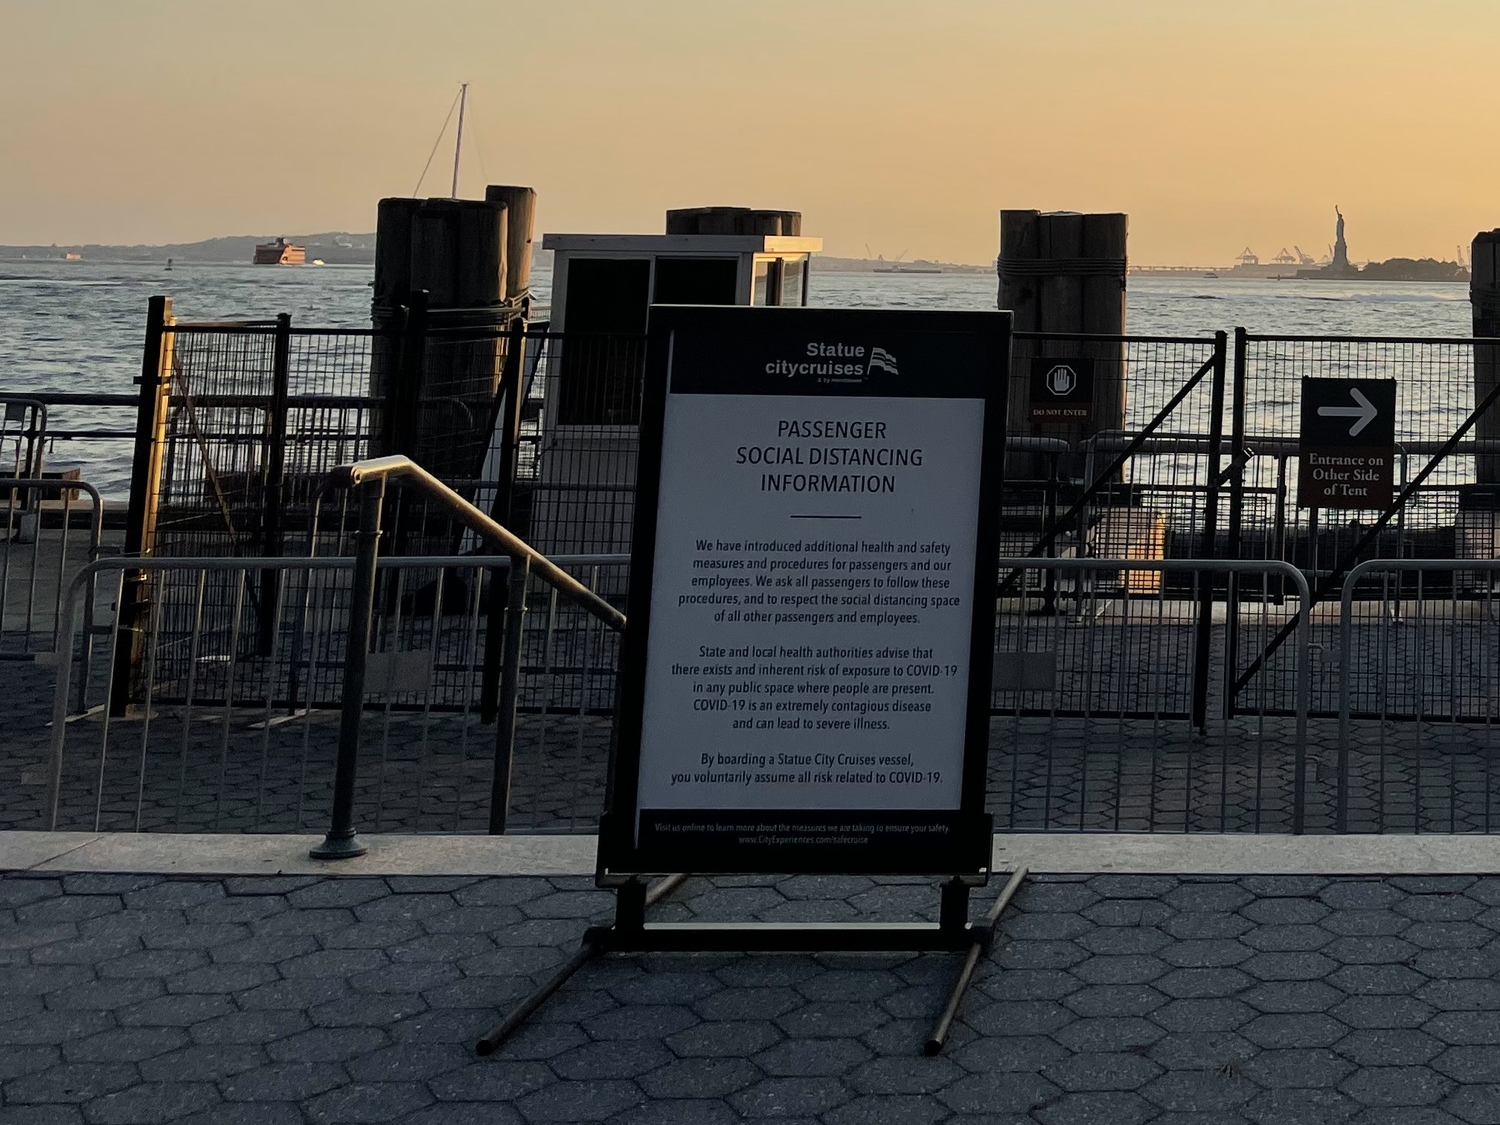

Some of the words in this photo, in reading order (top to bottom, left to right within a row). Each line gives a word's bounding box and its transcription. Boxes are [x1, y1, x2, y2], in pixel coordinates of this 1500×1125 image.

[807, 343, 864, 356] Statue
[766, 360, 863, 377] citycruises
[778, 421, 886, 438] PASSENGER
[736, 447, 804, 464] SOCIAL
[810, 448, 922, 466] DISTANCING
[1310, 453, 1364, 465] Entrance
[1313, 468, 1350, 480] Other
[1353, 469, 1379, 480] Side
[762, 474, 894, 493] INFORMATION
[1324, 483, 1338, 495] of
[1340, 484, 1367, 495] Tent
[696, 540, 713, 551] We
[716, 539, 741, 551] have
[745, 540, 802, 552] introduced
[805, 540, 858, 552] additional
[862, 541, 894, 552] health
[898, 542, 917, 553] and
[920, 541, 950, 556] safety
[693, 560, 744, 568] measures
[747, 557, 767, 569] and
[770, 558, 828, 572] procedures
[832, 557, 846, 570] for
[849, 562, 907, 573] passengers
[911, 559, 930, 570] and
[934, 562, 951, 570] our
[692, 574, 752, 589] employees.
[756, 575, 772, 586] We
[776, 576, 792, 587] ask
[796, 575, 808, 586] all
[811, 579, 870, 590] passengers
[874, 577, 883, 587] to
[887, 576, 918, 588] follow
[922, 577, 949, 588] these
[679, 593, 740, 607] procedures,
[744, 593, 764, 604] and
[768, 594, 777, 604] to
[781, 594, 818, 608] respect
[822, 594, 838, 604] the
[841, 594, 870, 605] social
[874, 594, 927, 609] distancing
[931, 597, 960, 609] space
[714, 609, 725, 621] of
[728, 610, 740, 621] all
[744, 610, 772, 622] other
[775, 614, 834, 625] passengers
[837, 611, 857, 622] and
[860, 611, 919, 626] employees.
[699, 646, 725, 657] State
[729, 646, 749, 657] and
[752, 646, 776, 657] local
[780, 646, 812, 657] health
[816, 647, 873, 658] authorities
[876, 647, 909, 658] advise
[913, 647, 932, 658] that
[672, 663, 699, 675] there
[703, 664, 732, 675] exists
[736, 663, 755, 675] and
[759, 663, 804, 675] inherent
[807, 664, 825, 675] risk
[829, 664, 840, 675] of
[843, 667, 890, 679] exposure
[894, 665, 903, 676] to
[907, 665, 957, 676] COVID-19
[693, 682, 703, 692] in
[706, 684, 725, 696] any
[729, 681, 761, 696] public
[765, 685, 794, 696] space
[797, 681, 829, 693] where
[833, 682, 869, 697] people
[872, 685, 888, 693] are
[892, 684, 934, 697] present.
[694, 699, 745, 711] COVID-19
[749, 700, 756, 711] is
[760, 702, 772, 711] an
[776, 699, 828, 714] extremely
[832, 701, 889, 714] contagious
[892, 700, 931, 712] disease
[733, 717, 753, 728] and
[756, 720, 774, 729] can
[778, 717, 800, 729] lead
[804, 718, 813, 729] to
[816, 721, 850, 729] severe
[854, 717, 889, 729] illness.
[701, 753, 714, 768] By
[718, 753, 765, 768] boarding
[769, 756, 774, 764] a
[778, 753, 811, 765] Statue
[815, 753, 835, 768] City
[838, 753, 875, 765] Cruises
[879, 753, 913, 767] vessel,
[671, 774, 690, 786] you
[694, 770, 752, 786] voluntarily
[755, 774, 795, 782] assume
[798, 771, 810, 783] all
[814, 771, 832, 782] risk
[836, 771, 872, 783] related
[876, 773, 885, 783] to
[889, 772, 942, 783] COVID-19.
